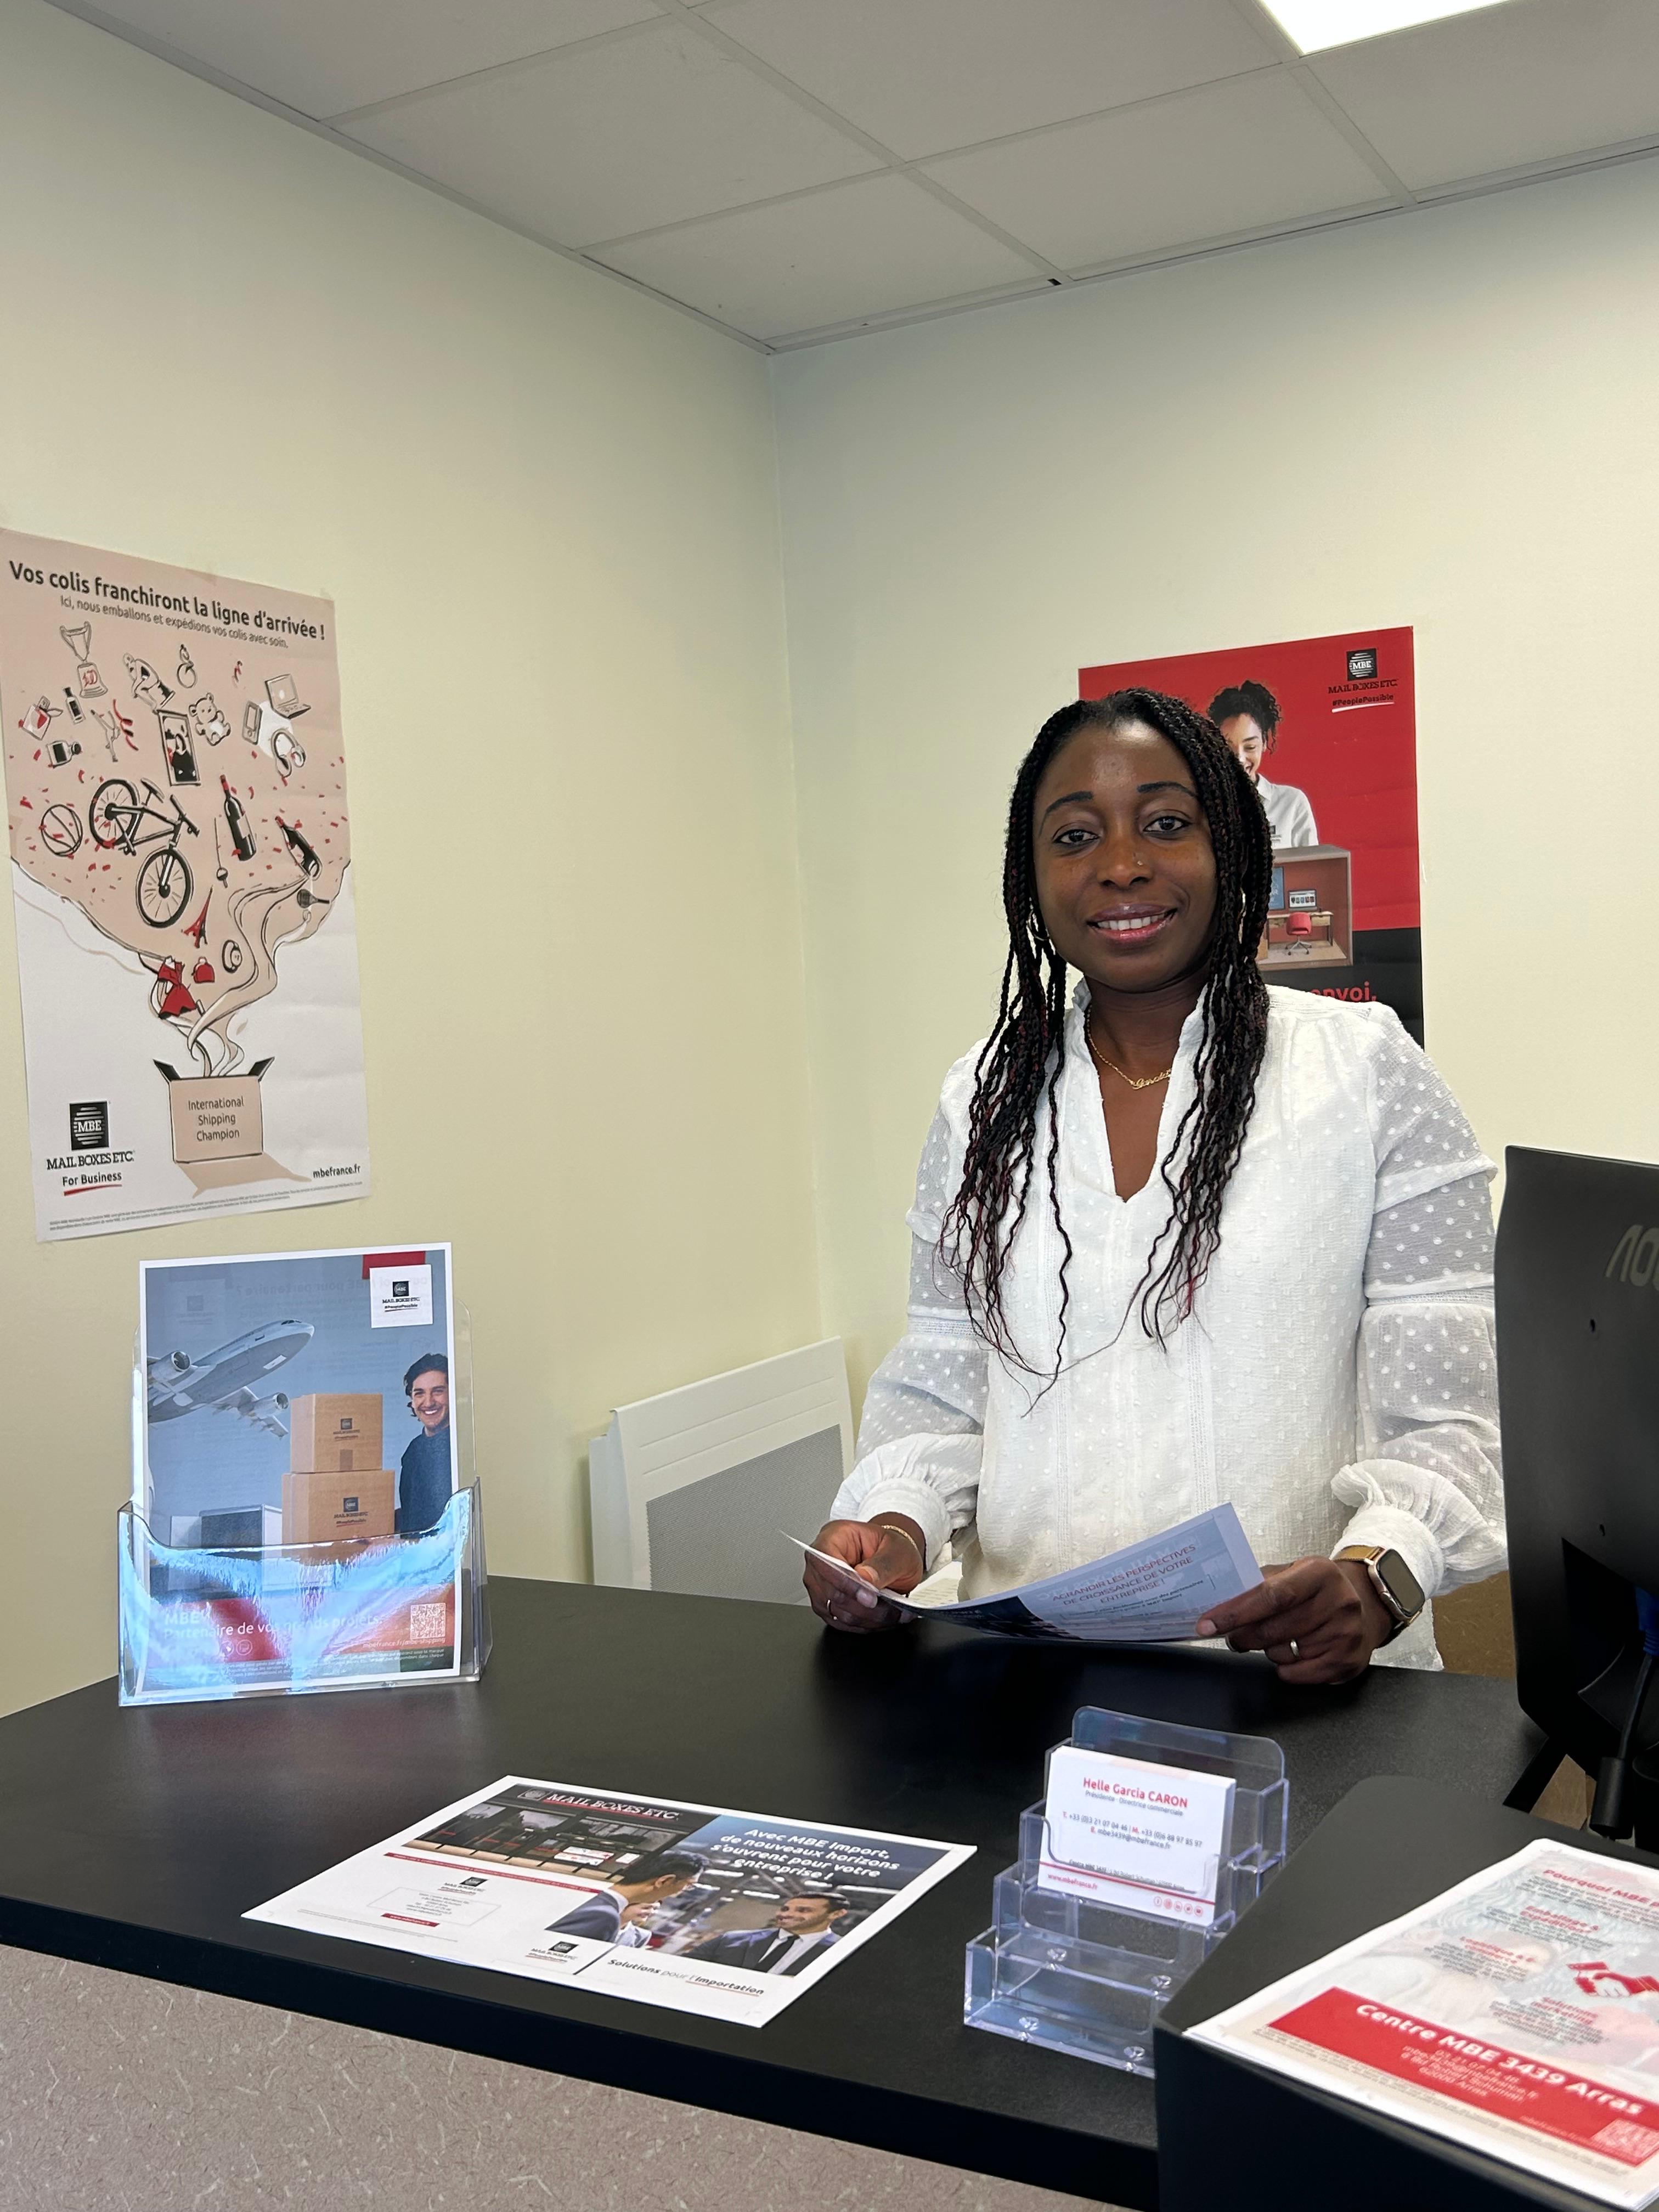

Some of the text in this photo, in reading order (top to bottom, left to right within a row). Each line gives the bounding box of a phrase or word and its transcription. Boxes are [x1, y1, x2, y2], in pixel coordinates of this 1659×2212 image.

[10, 560, 325, 640] Vos colis franchiront la ligne d'arrivée !
[77, 600, 100, 613] nous
[103, 605, 151, 623] emballons
[153, 614, 164, 625] et
[166, 616, 211, 634] expédions
[212, 627, 227, 637] vos
[229, 628, 247, 641] colis
[249, 633, 268, 645] avec
[1352, 661, 1372, 670] MBE
[1328, 685, 1351, 693] MAIL
[1352, 681, 1379, 691] BOXES
[1332, 694, 1393, 706] #PeoplePossible
[188, 1096, 245, 1111] International
[77, 1120, 102, 1133] MBE
[198, 1113, 236, 1126] Shipping
[196, 1129, 240, 1142] Champion
[47, 1156, 77, 1170] MAIL
[77, 1153, 112, 1167] BOXES
[313, 1164, 361, 1180] mbefrance.fr
[62, 1171, 122, 1186] For Business
[1604, 1224, 1659, 1291] AO
[1053, 1544, 1196, 1601] AGRANDIR LES PERSPECTIVES
[1080, 1579, 1142, 1602] CROISSANCE
[1144, 1572, 1158, 1581] DE
[1159, 1556, 1193, 1574] VOTRE
[1100, 1581, 1160, 1603] ENTREPRISE
[165, 1611, 201, 1624] MBE
[165, 1624, 234, 1638] Partenaire
[237, 1622, 254, 1635] de
[547, 1793, 591, 1807] MAIL
[591, 1799, 644, 1814] BOXES
[1084, 1778, 1188, 1808] Helle Garcia CARON
[1119, 1797, 1146, 1808] Directrice
[1147, 1803, 1183, 1816] commerciale
[744, 1829, 890, 1859] Avec MBE Import,
[1102, 1819, 1110, 1827] 07
[1195, 1839, 1203, 1848] 97
[710, 1842, 881, 1877] s'ouvrent pour votre
[720, 1835, 900, 1870] de nouveaux horizons
[732, 1858, 822, 1878] entreprise
[1543, 1869, 1649, 1903] Pourquoi MBE
[1525, 1905, 1588, 1927] Emballage
[1460, 1936, 1514, 1956] Logistique
[608, 1959, 764, 1995] Solutions pour l'Importation
[1531, 2001, 1594, 2025] marketing
[1542, 1996, 1599, 2019] Solutions
[1356, 2004, 1645, 2115] Centre MBE 3439 Arras
